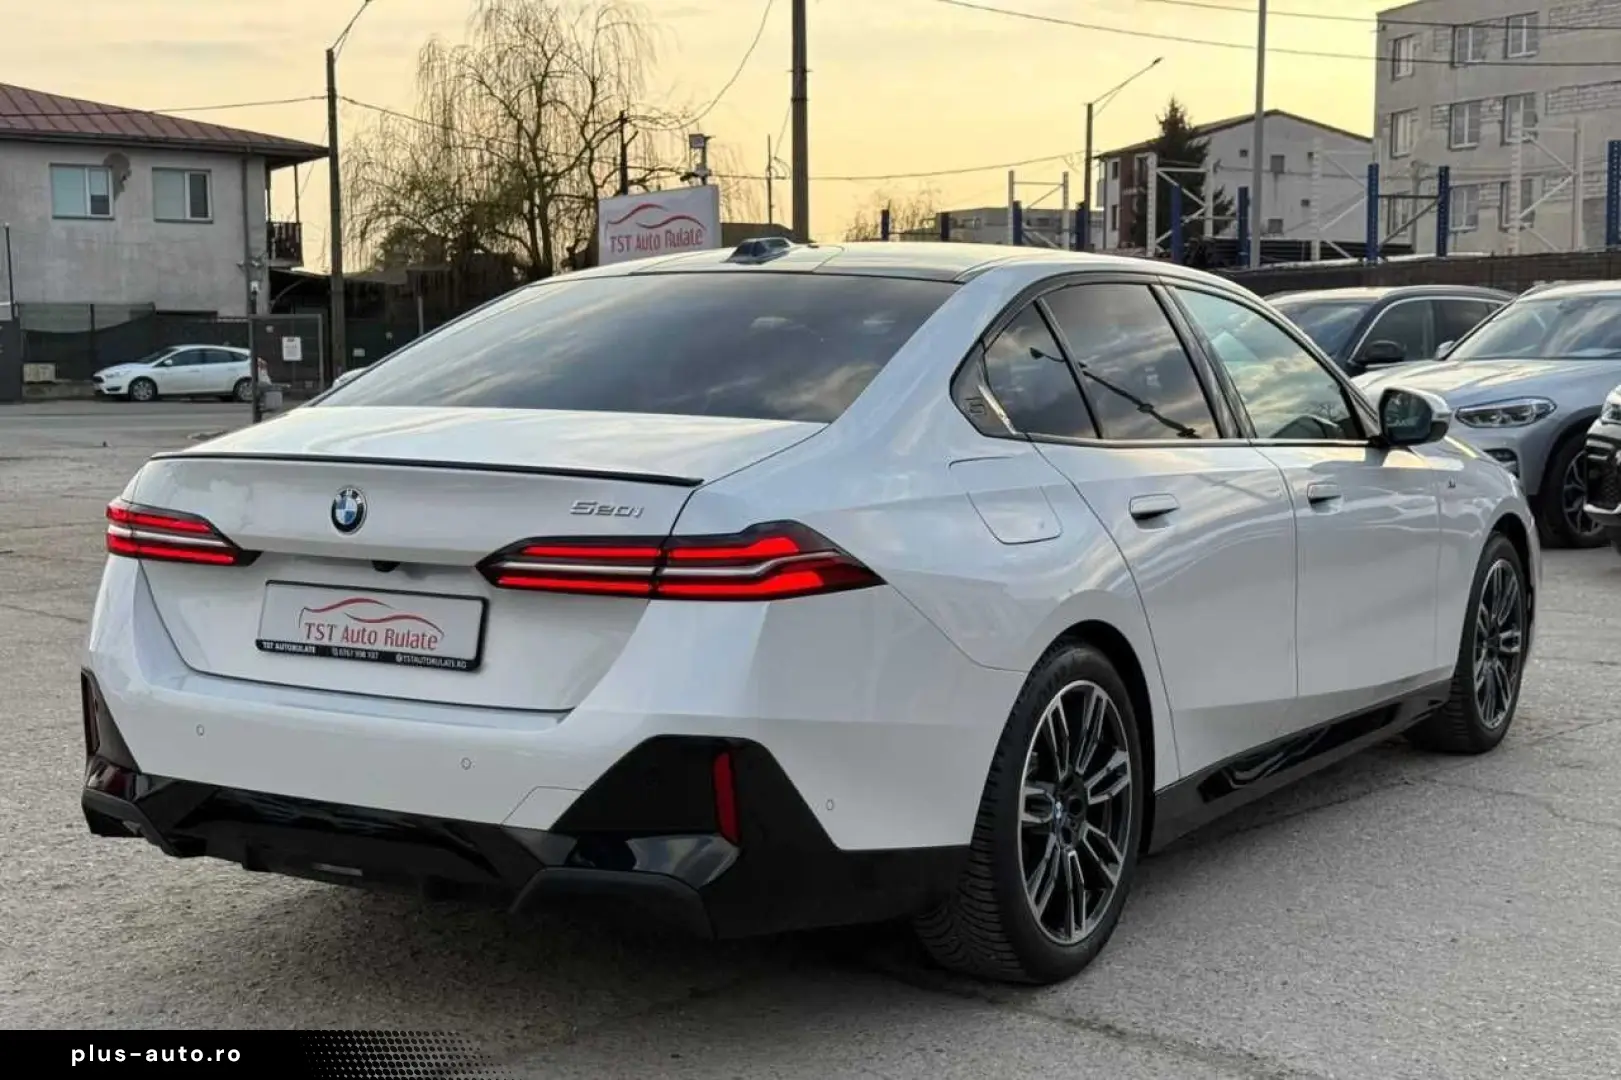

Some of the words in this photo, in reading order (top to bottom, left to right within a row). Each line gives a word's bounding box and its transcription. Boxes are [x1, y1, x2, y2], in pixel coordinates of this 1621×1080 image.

[610, 234, 632, 253] TST
[635, 232, 660, 251] Auto
[665, 228, 703, 249] Rulate
[569, 500, 644, 519] 520i
[262, 641, 274, 649] TST
[305, 622, 337, 642] TST
[341, 624, 377, 646] Auto
[384, 627, 438, 650] Rulate
